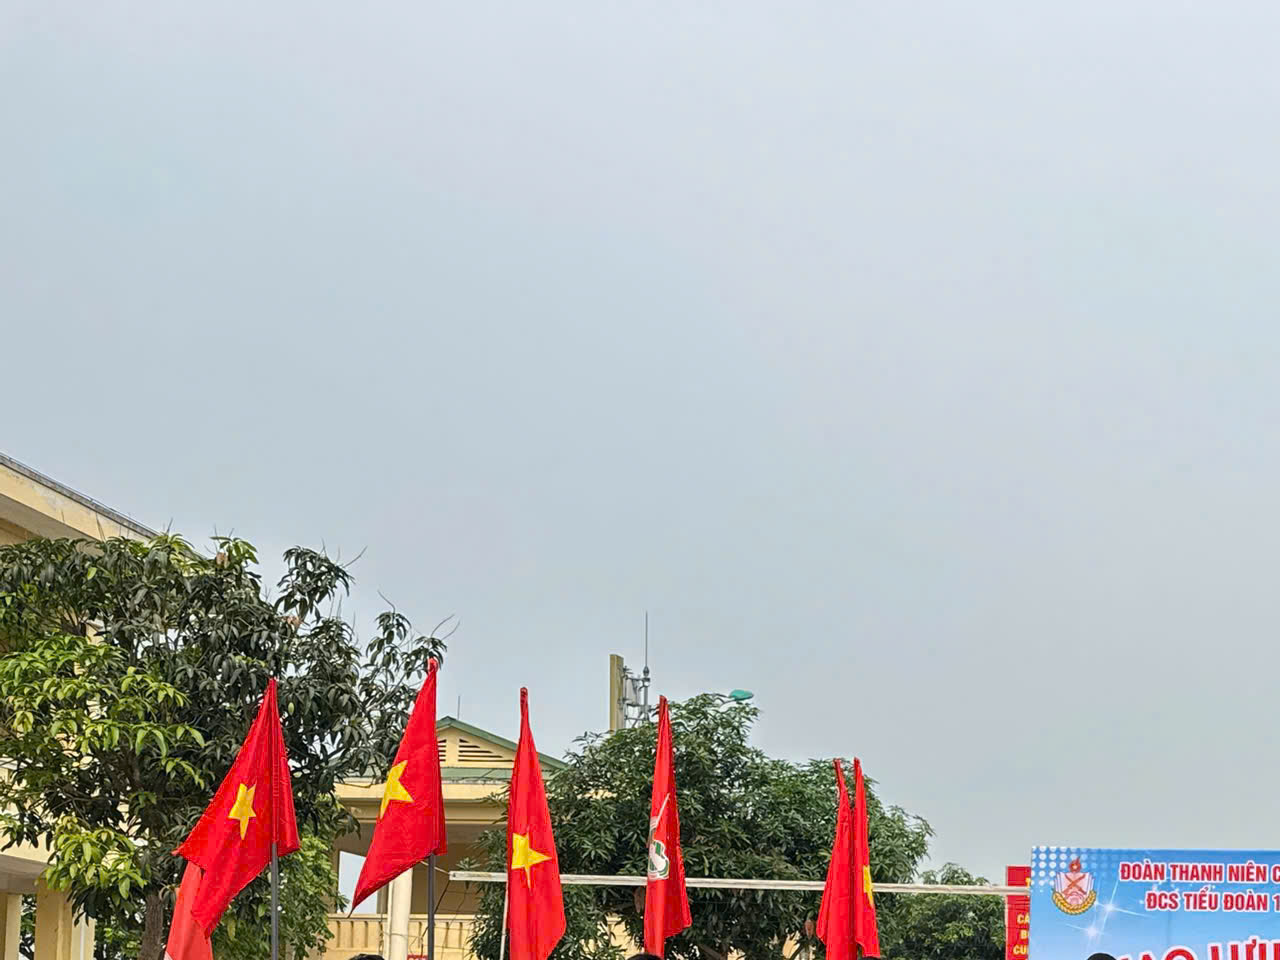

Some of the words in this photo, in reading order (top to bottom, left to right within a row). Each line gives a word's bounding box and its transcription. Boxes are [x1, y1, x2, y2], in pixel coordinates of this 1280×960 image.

[1120, 860, 1166, 881] ĐOÀN
[1170, 864, 1223, 882] THANH
[1228, 862, 1267, 882] NIÊN
[1146, 892, 1179, 910] ĐCS
[1183, 886, 1219, 910] TIỂU
[1223, 890, 1268, 911] ĐOÀN
[1272, 895, 1280, 911] 1
